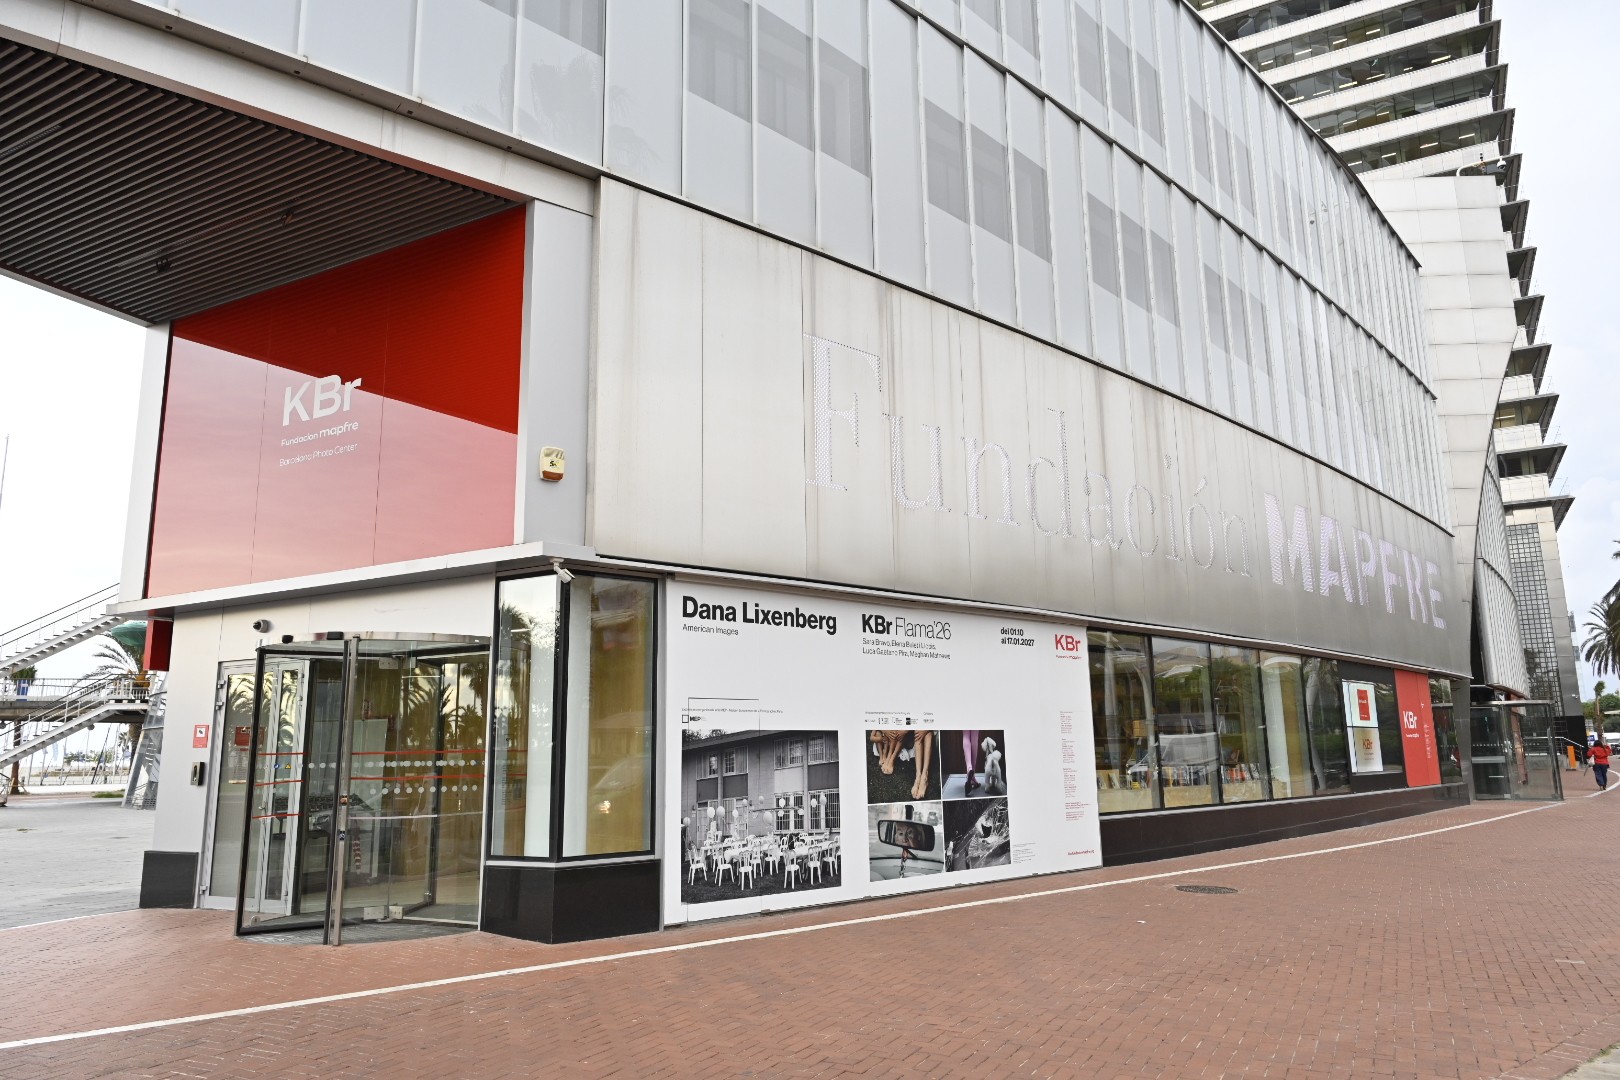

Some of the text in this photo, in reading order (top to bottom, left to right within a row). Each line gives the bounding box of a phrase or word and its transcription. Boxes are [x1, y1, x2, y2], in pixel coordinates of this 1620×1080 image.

[282, 374, 362, 427] KBr
[319, 421, 359, 437] mapfre
[279, 443, 358, 467] Barcelona Photo Center
[802, 333, 1448, 630] Fundación MAPFRE
[682, 596, 837, 635] Dana Lixenberg
[862, 613, 893, 635] KBr
[682, 623, 739, 636] American Images
[1000, 627, 1010, 636] del
[862, 637, 875, 645] Sara
[875, 639, 891, 647] Bravo,
[891, 640, 905, 648] Elena
[1001, 637, 1035, 647] al 17.01.2027
[1054, 634, 1081, 652] KBr
[862, 647, 876, 655] Luca
[910, 651, 929, 659] Meghan
[1403, 710, 1418, 729] KBr
